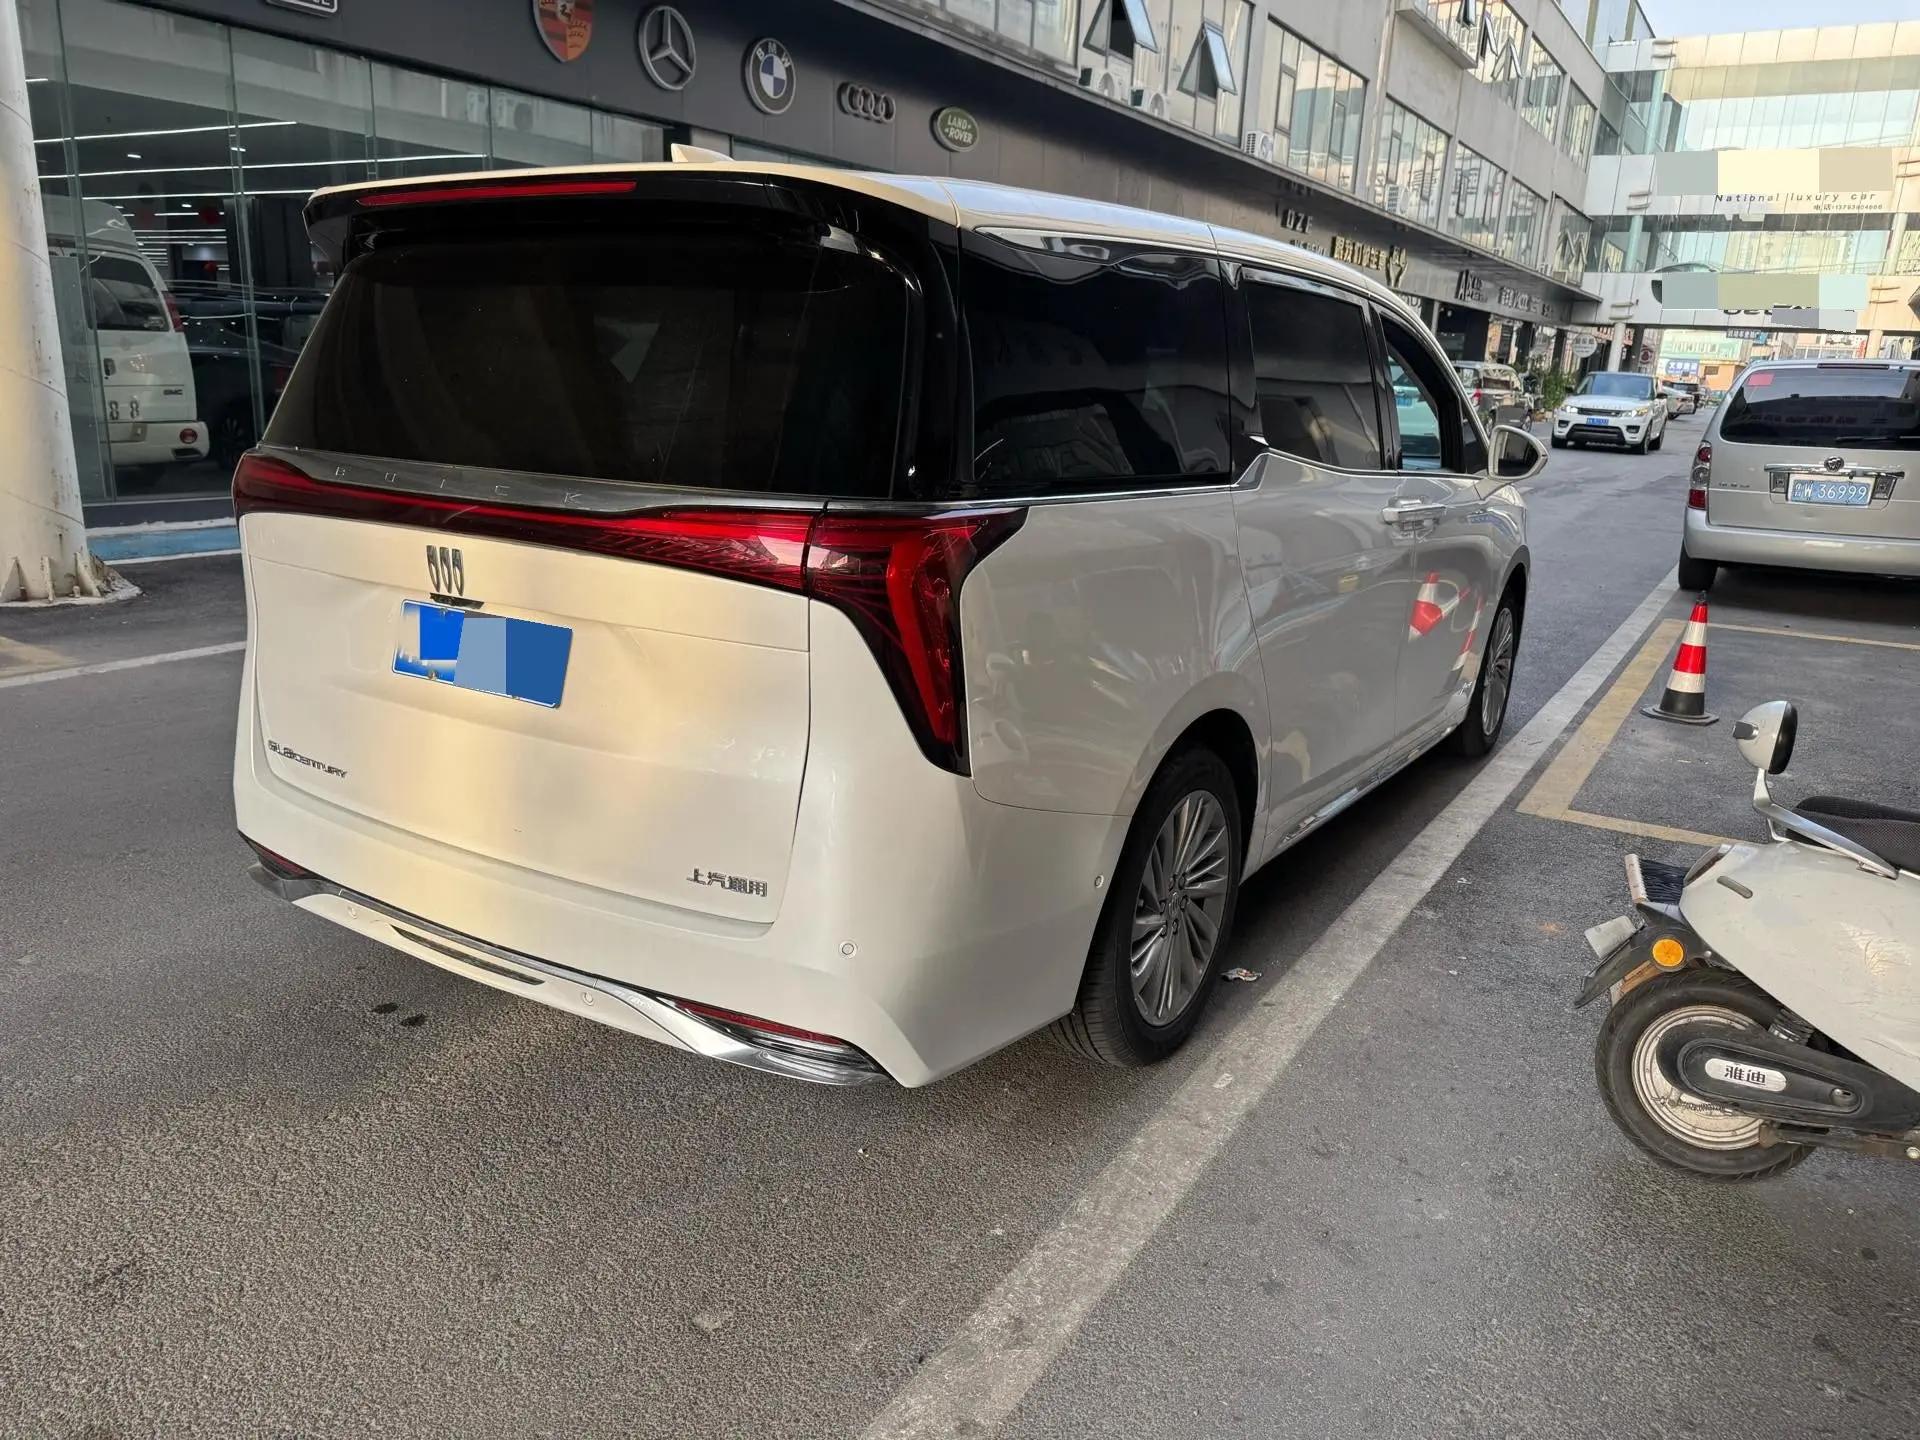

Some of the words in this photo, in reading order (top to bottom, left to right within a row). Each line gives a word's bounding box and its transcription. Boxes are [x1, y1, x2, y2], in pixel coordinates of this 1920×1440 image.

[756, 41, 791, 68] BMW
[947, 114, 968, 130] LAND
[949, 127, 973, 144] ROVER
[1715, 193, 1780, 202] National
[1790, 193, 1840, 203] luxury
[1850, 192, 1877, 201] car
[335, 465, 582, 504] BUICK
[685, 867, 768, 897] 上汽通用
[1724, 1065, 1766, 1086] 雅迪
